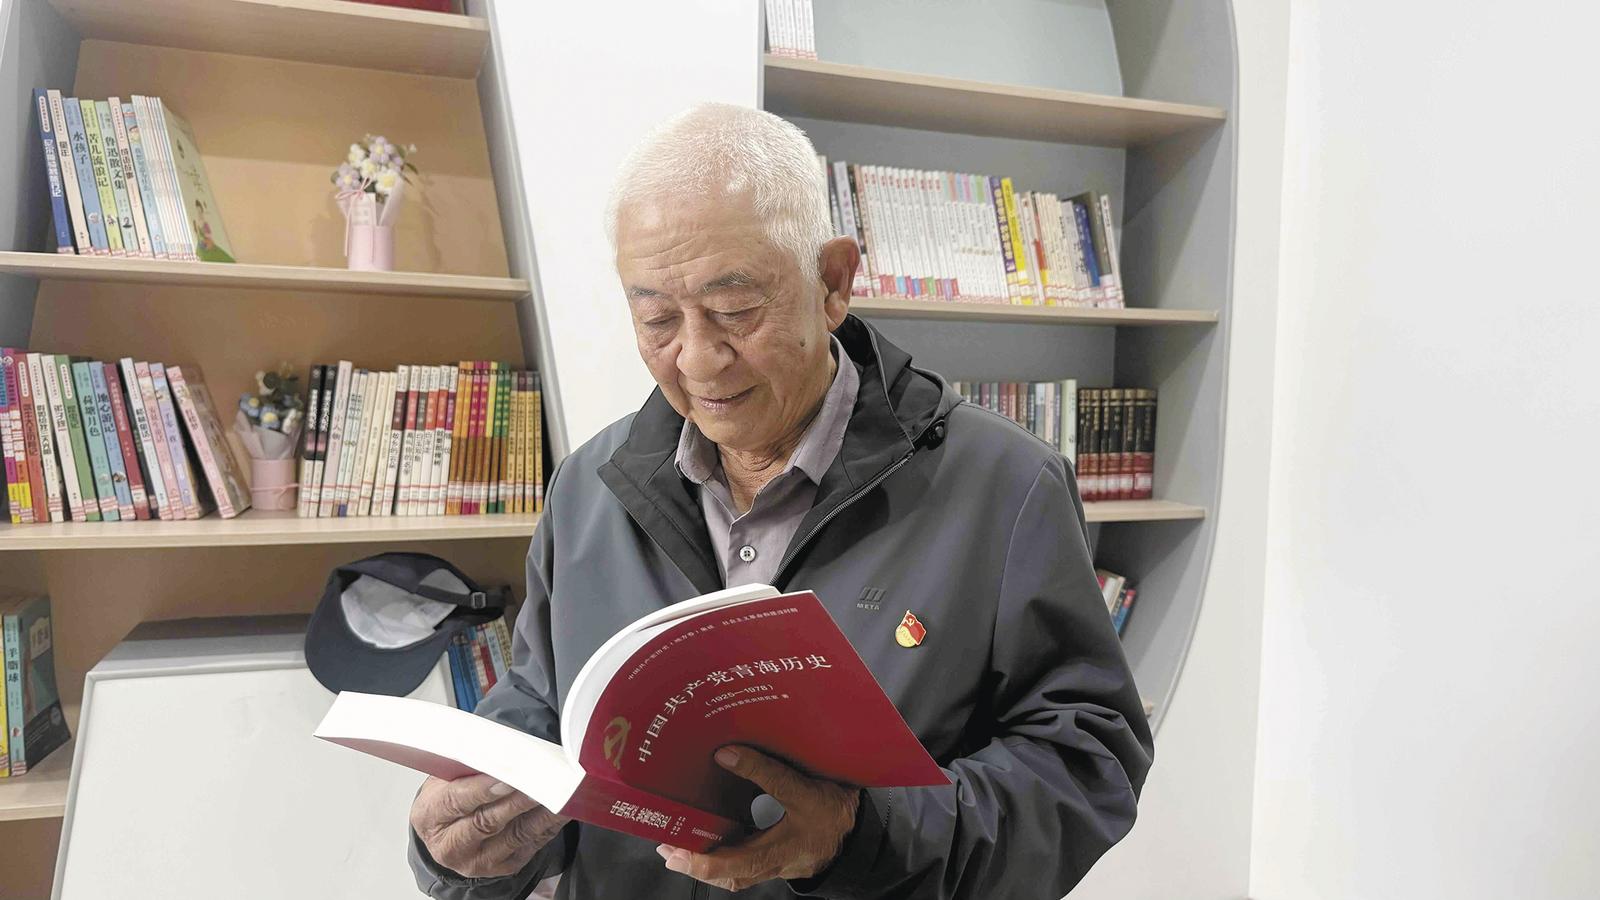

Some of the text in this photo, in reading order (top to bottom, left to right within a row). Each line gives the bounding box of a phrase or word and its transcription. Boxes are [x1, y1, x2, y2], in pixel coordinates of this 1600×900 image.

[89, 134, 108, 187] 苦儿流浪记
[105, 137, 125, 190] 鲁迅散文集
[83, 395, 101, 437] 荷塘月色
[97, 393, 115, 433] 地心游记
[638, 653, 832, 763] 中国共产党青海历史
